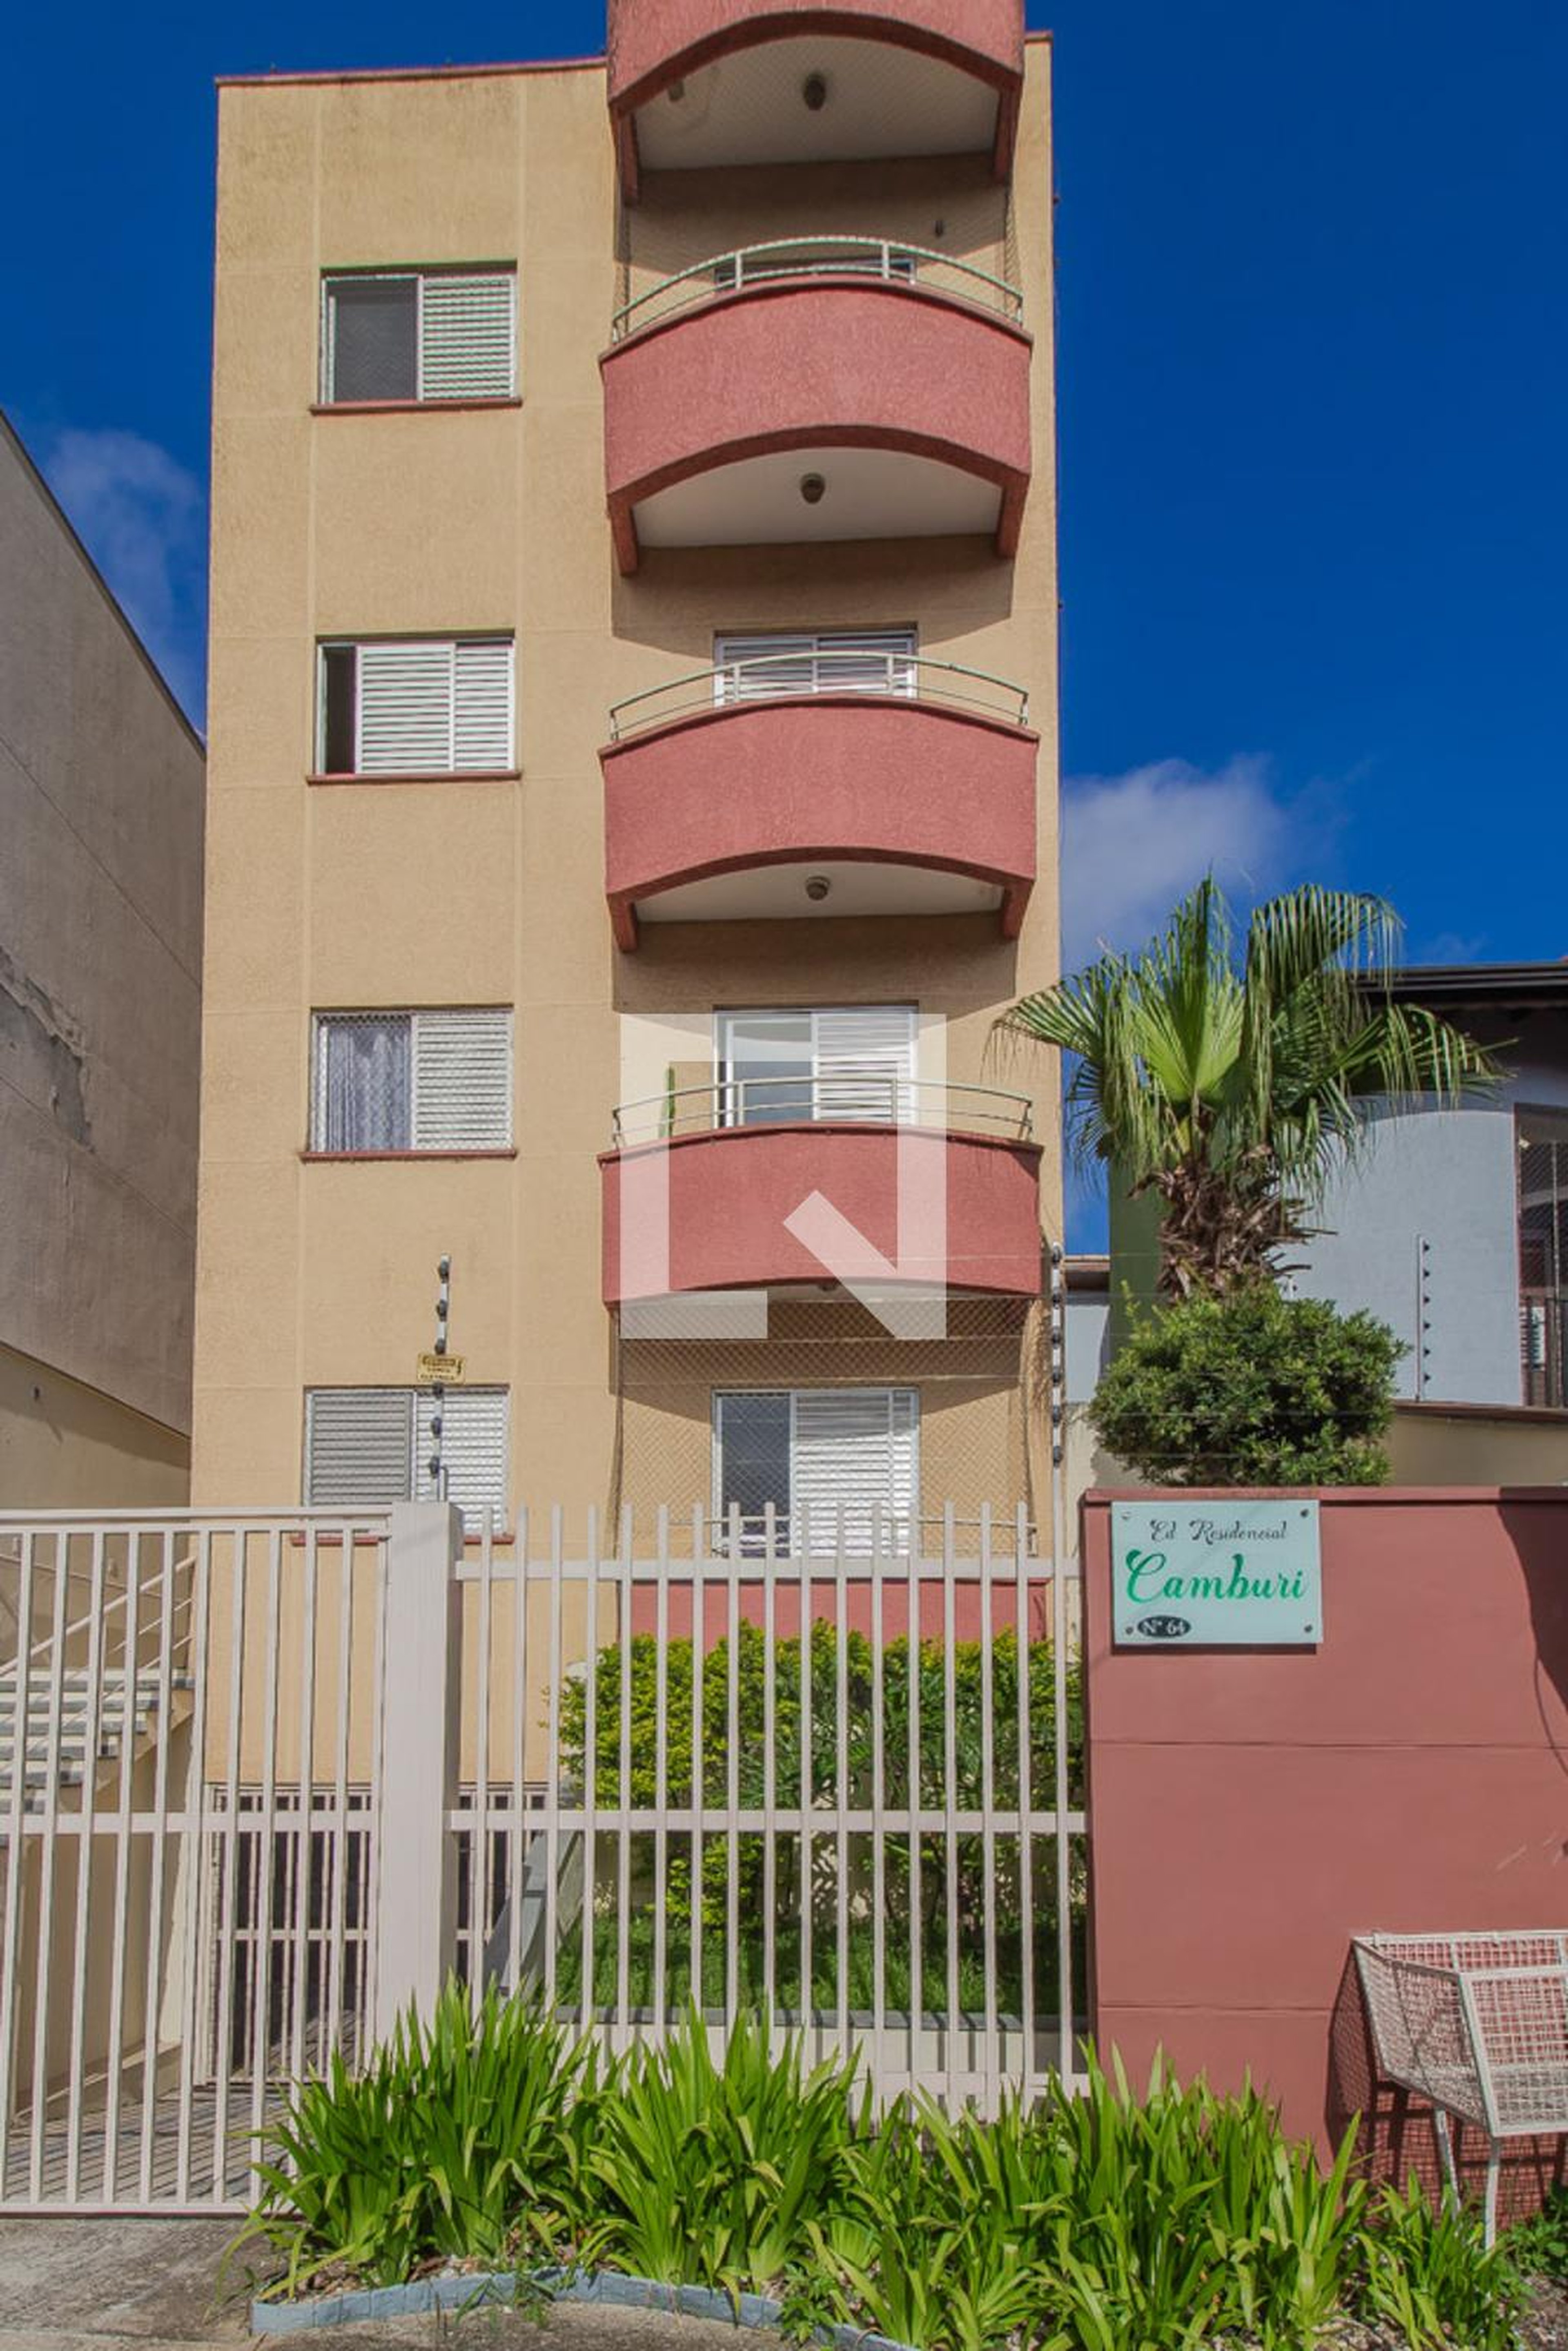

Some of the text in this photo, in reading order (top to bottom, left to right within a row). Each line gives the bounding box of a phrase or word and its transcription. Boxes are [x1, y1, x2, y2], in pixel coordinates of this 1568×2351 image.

[1149, 1519, 1286, 1545] Ed Residencial
[1126, 1549, 1306, 1604] Camburi
[1167, 1619, 1185, 1634] 64
